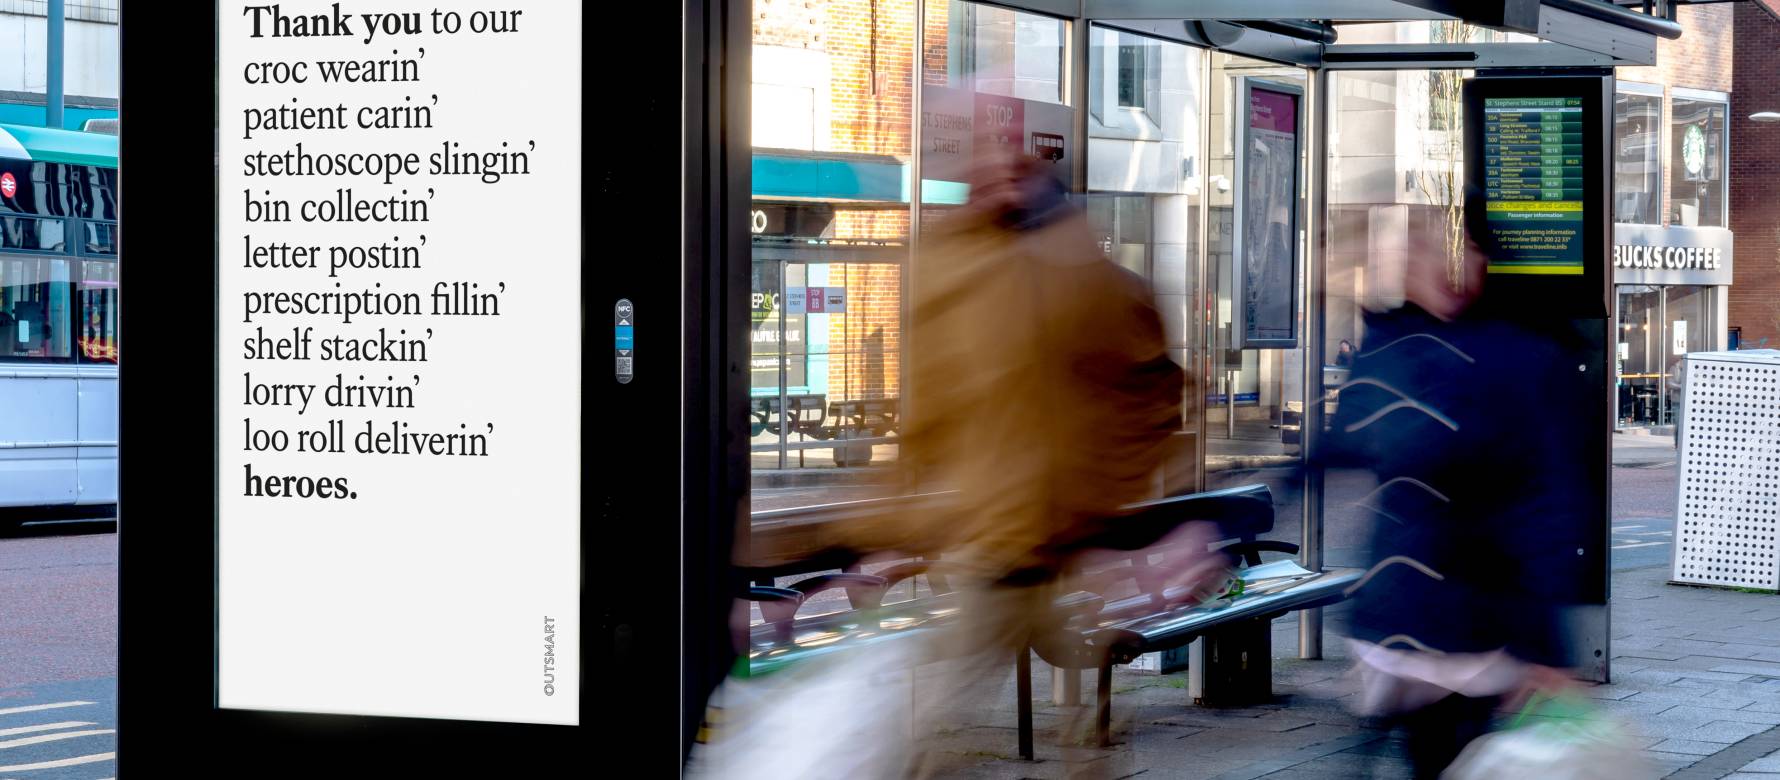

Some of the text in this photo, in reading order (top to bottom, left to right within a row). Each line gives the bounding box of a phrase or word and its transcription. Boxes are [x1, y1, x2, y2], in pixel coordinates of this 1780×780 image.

[244, 3, 522, 44] Thank you to our
[244, 48, 424, 84] croc wearin’
[243, 94, 437, 139] patient carin’
[935, 113, 972, 131] STEPHENS
[986, 104, 1013, 127] STOP
[244, 140, 535, 184] stethoscope slingin’
[934, 138, 960, 154] STREET
[244, 188, 434, 222] bin collectin’
[1506, 202, 1537, 210] changes
[244, 235, 425, 277] letter postin’
[1665, 246, 1721, 269] COFFEE
[243, 282, 505, 323] prescription fillin’
[244, 327, 432, 361] shelf stackin’
[244, 372, 419, 415] lorry drivin’
[244, 418, 493, 456] loo roll deliverin’
[244, 464, 357, 499] heroes.
[544, 615, 555, 697] OUTSMART
